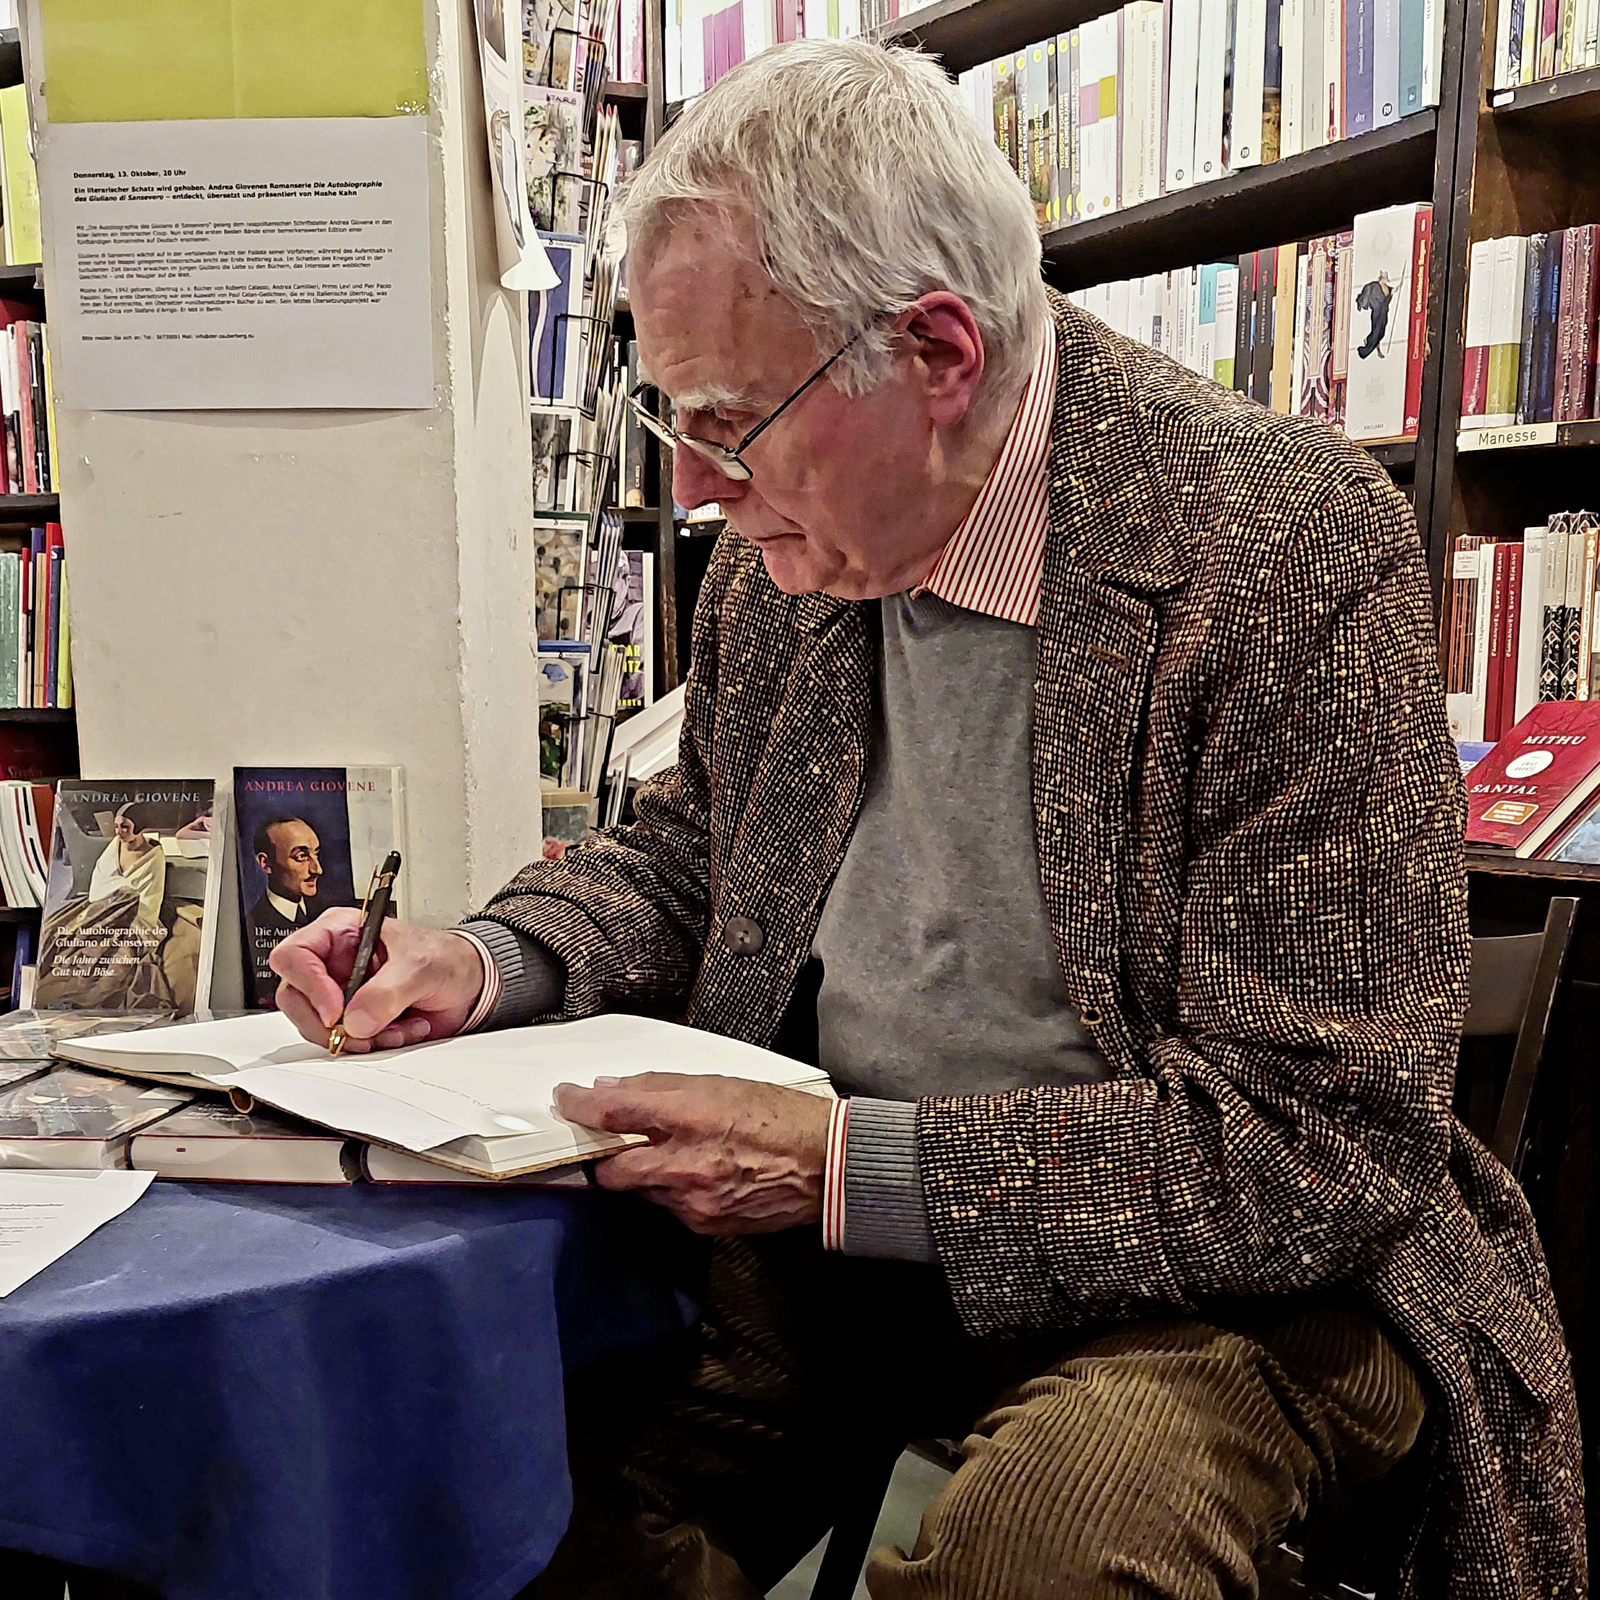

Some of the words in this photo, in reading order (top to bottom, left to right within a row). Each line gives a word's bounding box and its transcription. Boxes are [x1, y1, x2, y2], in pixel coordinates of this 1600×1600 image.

[1355, 112, 1366, 122] dtv
[73, 171, 115, 179] Donnerstag,
[326, 180, 382, 188] Autobiographie
[1415, 266, 1424, 313] Griechische
[1406, 416, 1418, 425] dtv
[1478, 430, 1537, 446] Manesse
[1491, 613, 1500, 657] EMMANUEL
[1522, 736, 1587, 745] MITHU
[245, 781, 304, 792] ANDREA
[310, 781, 376, 792] GIOVENE
[1470, 784, 1539, 795] SANYAL
[70, 793, 129, 803] ANDREA
[134, 793, 200, 802] GIOVENE
[57, 926, 73, 935] Die
[76, 926, 150, 938] Autobiographie
[152, 926, 168, 936] des
[255, 927, 274, 936] Die
[55, 938, 98, 948] Giuliano
[100, 938, 110, 948] di
[112, 938, 159, 948] Sansevero
[53, 955, 70, 964] Die
[72, 955, 97, 966] Jahre
[99, 955, 140, 964] zwischen
[52, 967, 70, 977] Gut
[73, 967, 90, 976] und
[93, 967, 114, 977] Böse
